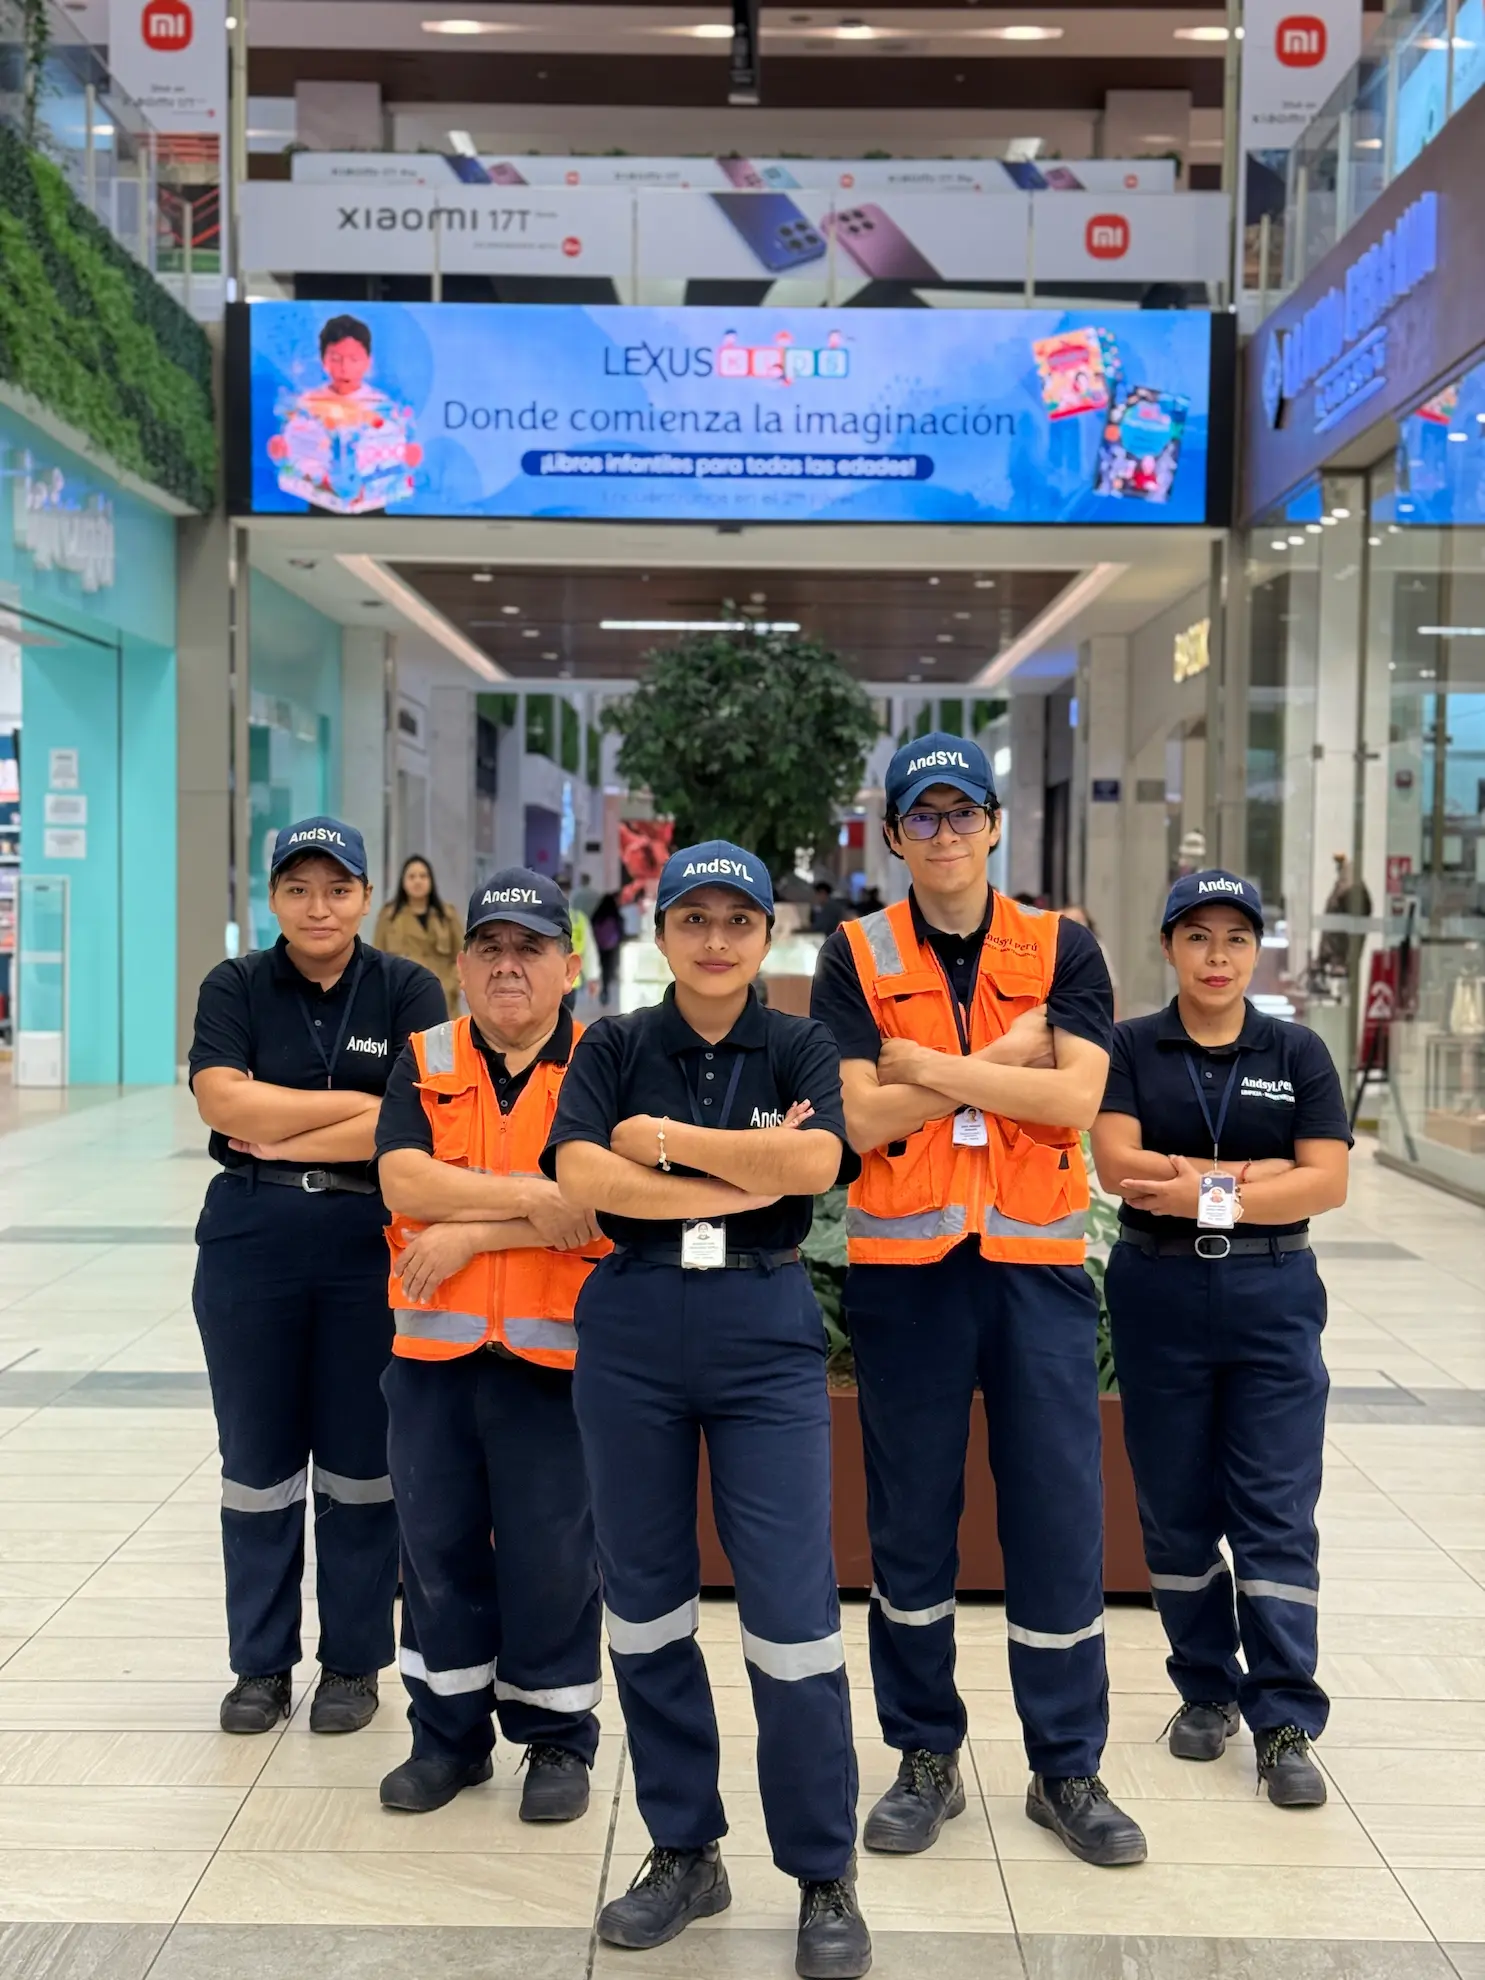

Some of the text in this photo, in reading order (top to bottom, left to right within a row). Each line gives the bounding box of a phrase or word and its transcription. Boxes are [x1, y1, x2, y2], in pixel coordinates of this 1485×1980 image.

[488, 209, 531, 232] 17T
[604, 340, 713, 383] LEXUS
[444, 400, 1016, 444] Donde comienza la imaginación
[605, 453, 693, 475] infantiles
[695, 456, 744, 478] para
[907, 750, 969, 775] AndSYL
[288, 827, 346, 847] AndSYL
[682, 857, 754, 883] AndSYL
[481, 887, 542, 906] AndSYL
[1198, 877, 1244, 895] Andsyl
[985, 933, 1013, 948] ndsyl
[346, 1035, 388, 1058] Andsyl
[750, 1106, 786, 1128] Ands
